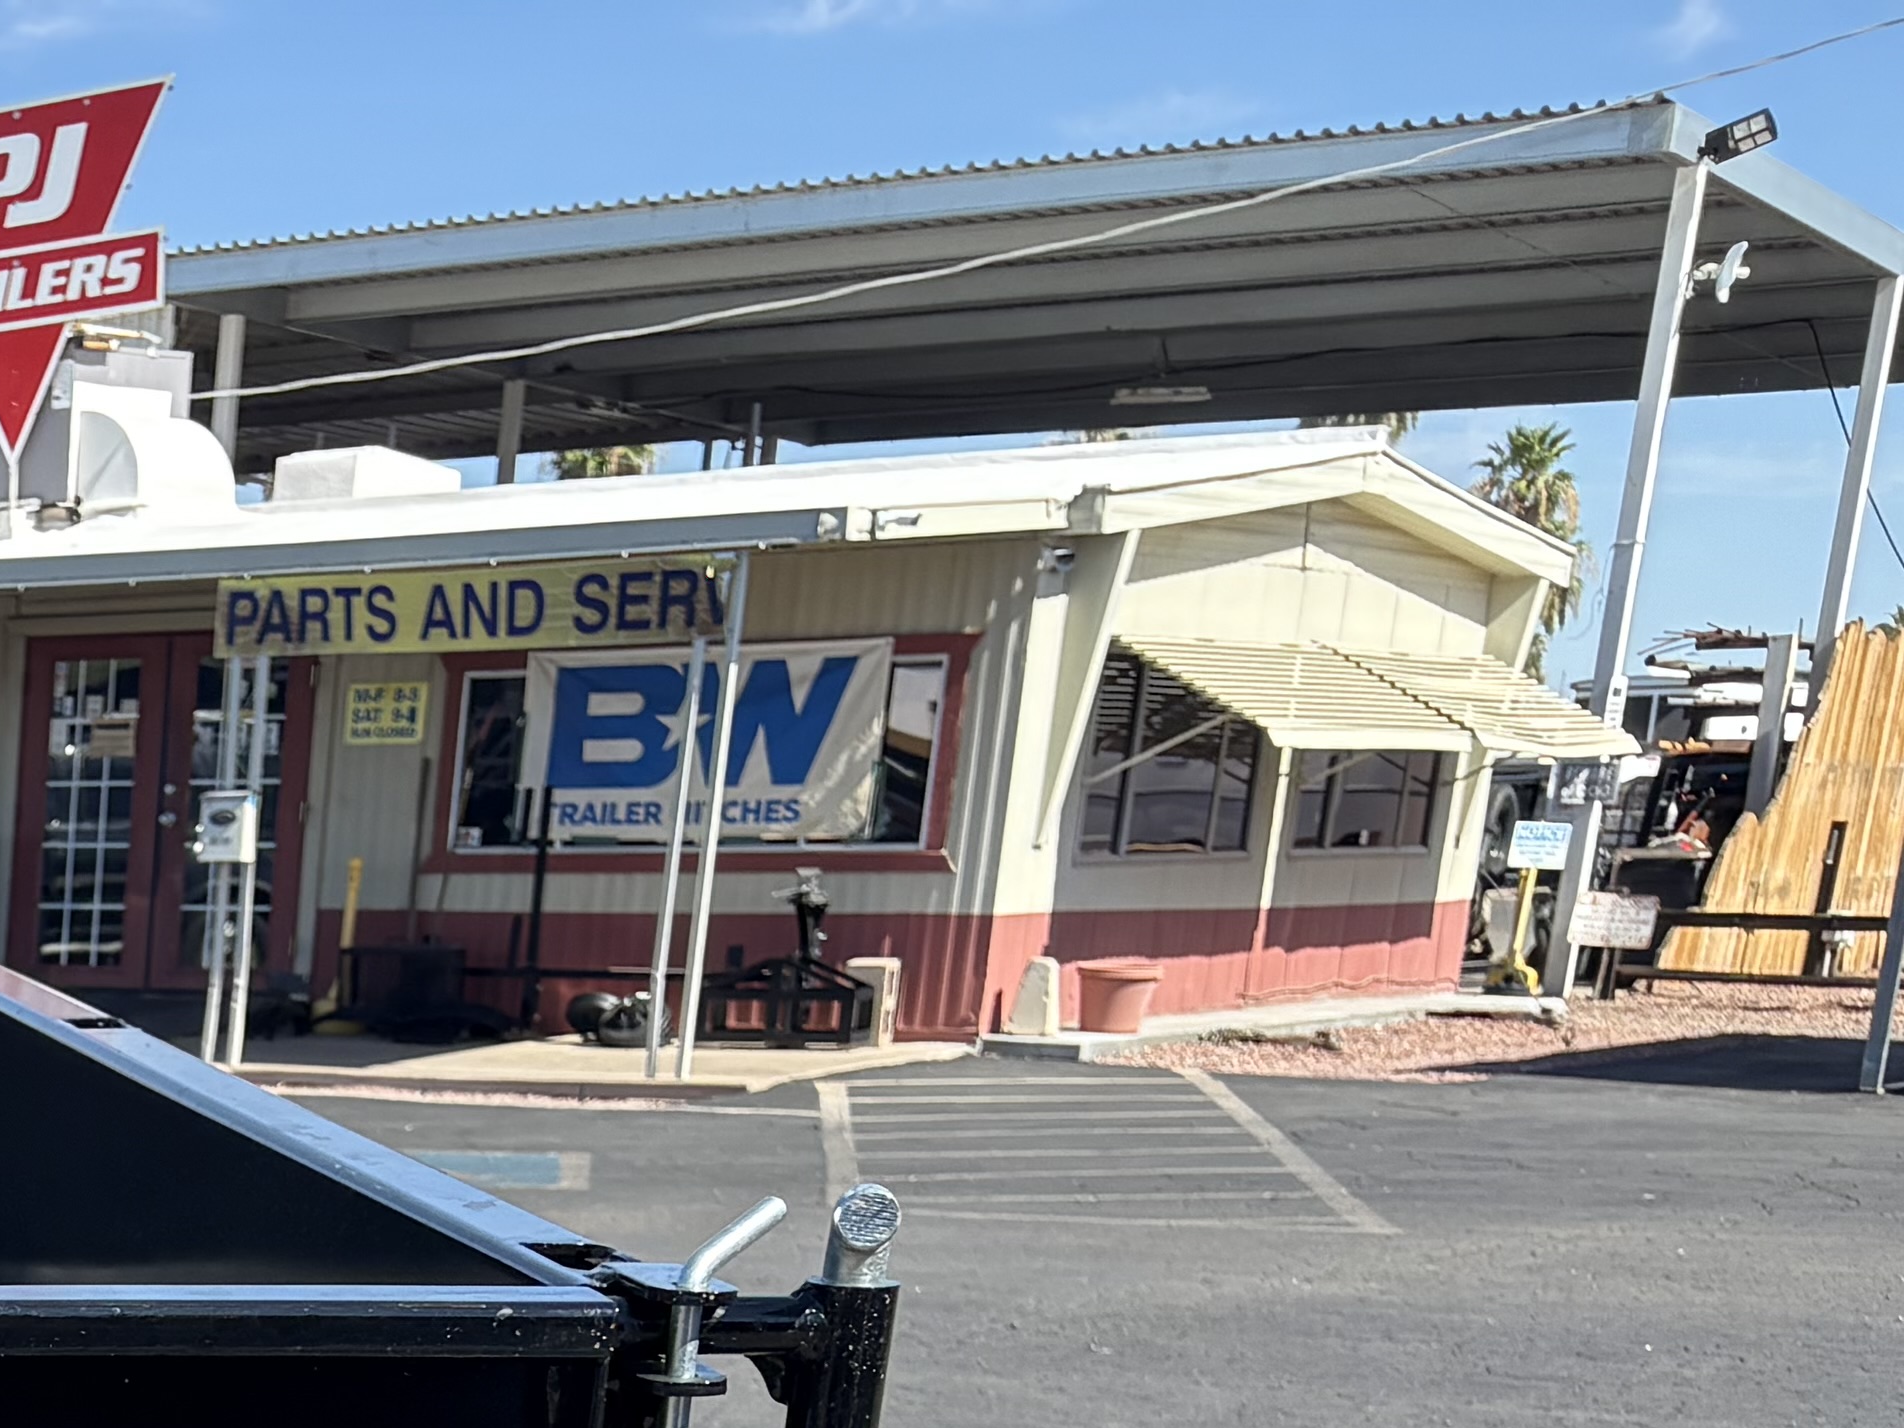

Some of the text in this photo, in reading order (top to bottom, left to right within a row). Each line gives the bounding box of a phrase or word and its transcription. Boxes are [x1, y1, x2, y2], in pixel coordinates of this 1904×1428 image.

[226, 584, 398, 646] PARTS
[420, 578, 546, 642] AND
[685, 799, 801, 826] ICHES
